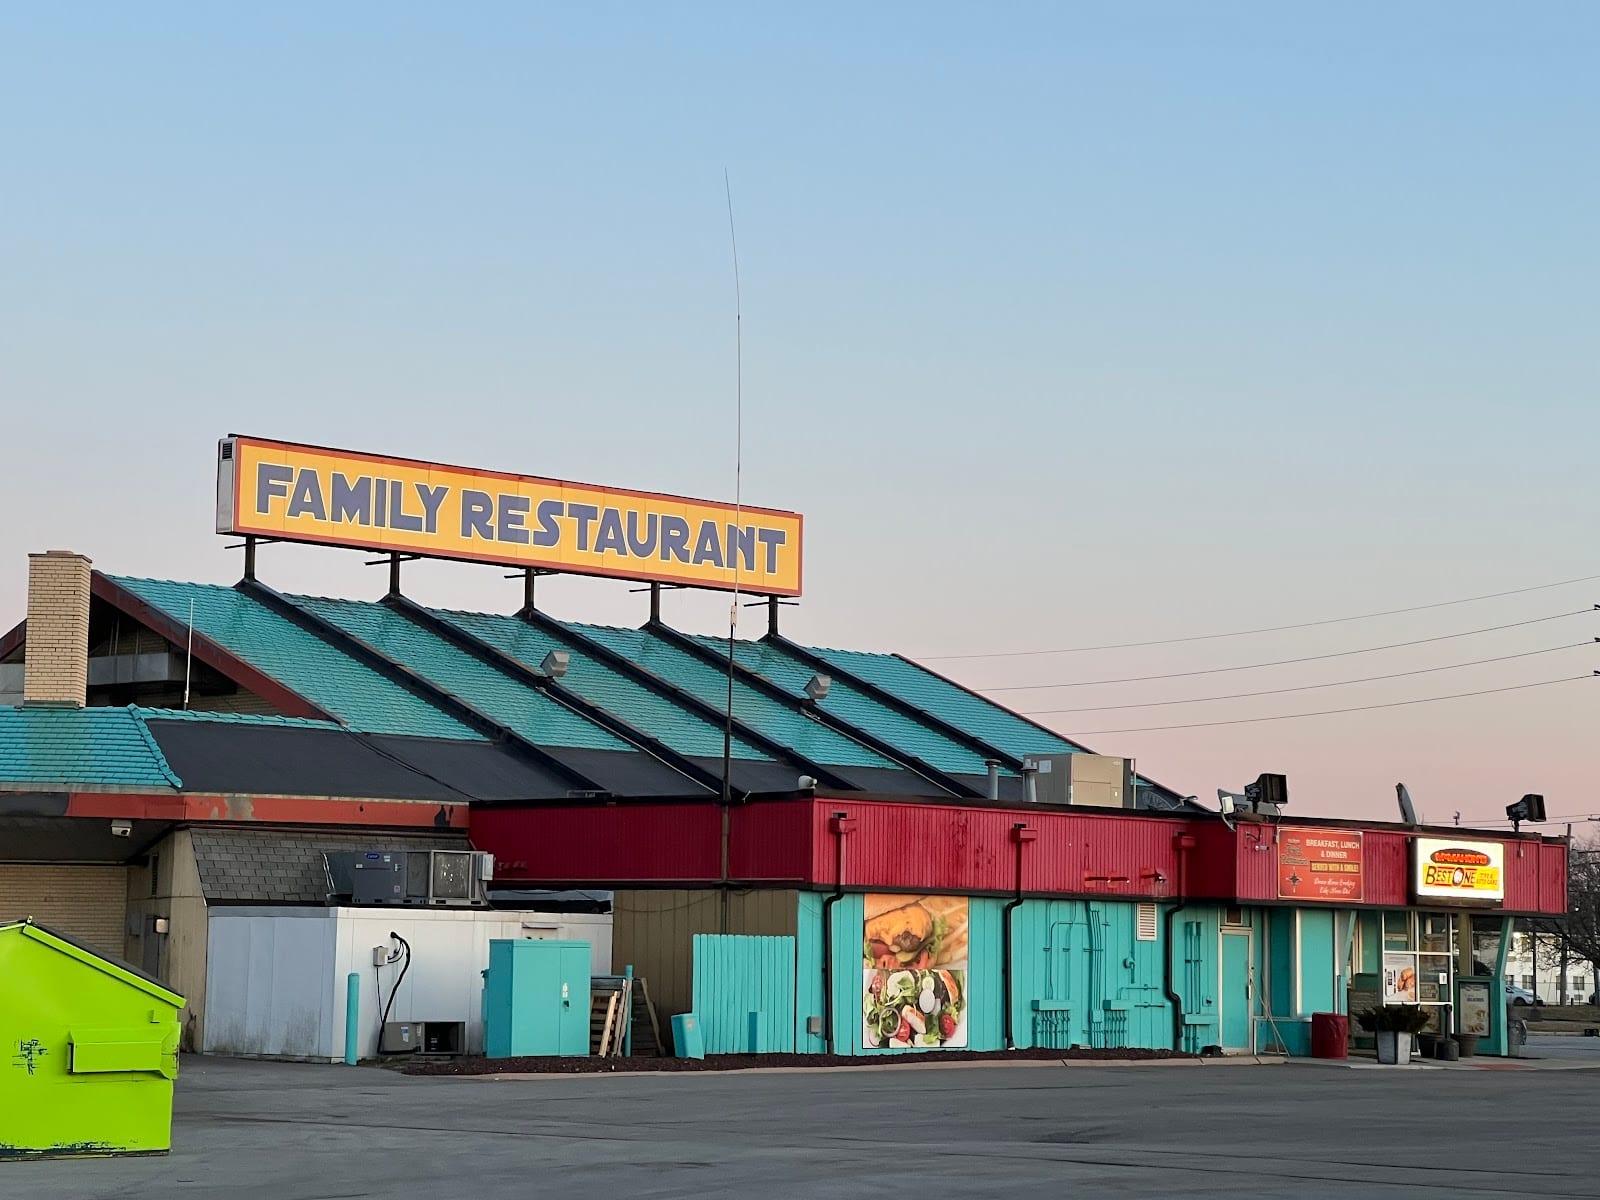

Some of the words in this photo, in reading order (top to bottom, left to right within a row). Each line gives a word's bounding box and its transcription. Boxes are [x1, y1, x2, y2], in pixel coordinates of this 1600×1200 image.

[255, 461, 450, 535] FAMILY
[459, 489, 787, 575] RESTAURANT
[1306, 839, 1339, 849] BREAKFAST,
[1340, 840, 1360, 849] LUNCH
